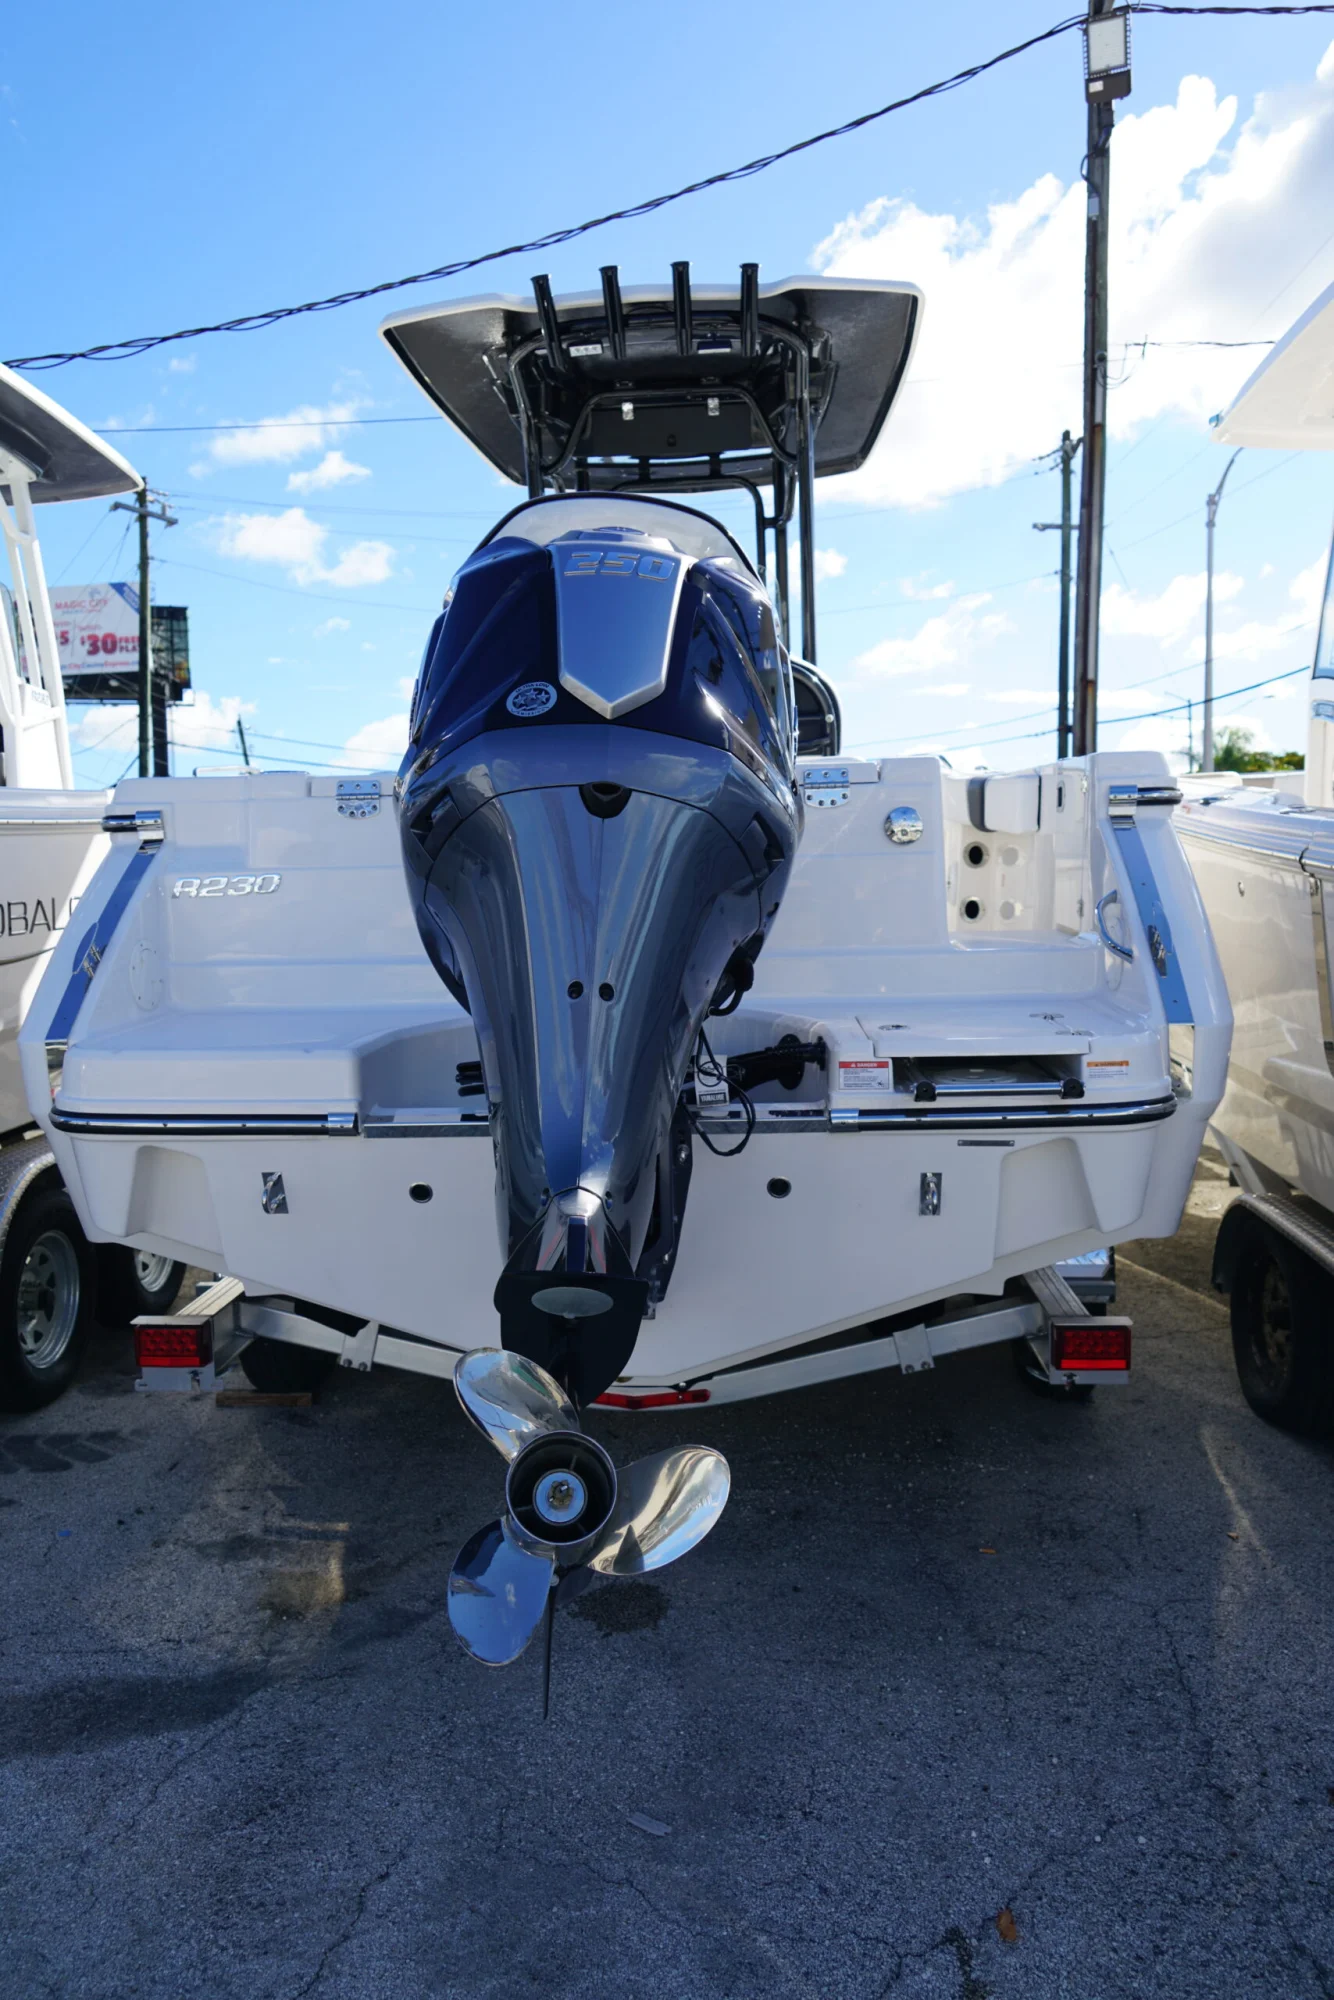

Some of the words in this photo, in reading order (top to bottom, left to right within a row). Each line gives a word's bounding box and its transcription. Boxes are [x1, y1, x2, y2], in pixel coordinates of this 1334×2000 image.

[564, 551, 675, 581] 250
[80, 632, 118, 656] $30
[171, 872, 282, 898] R230
